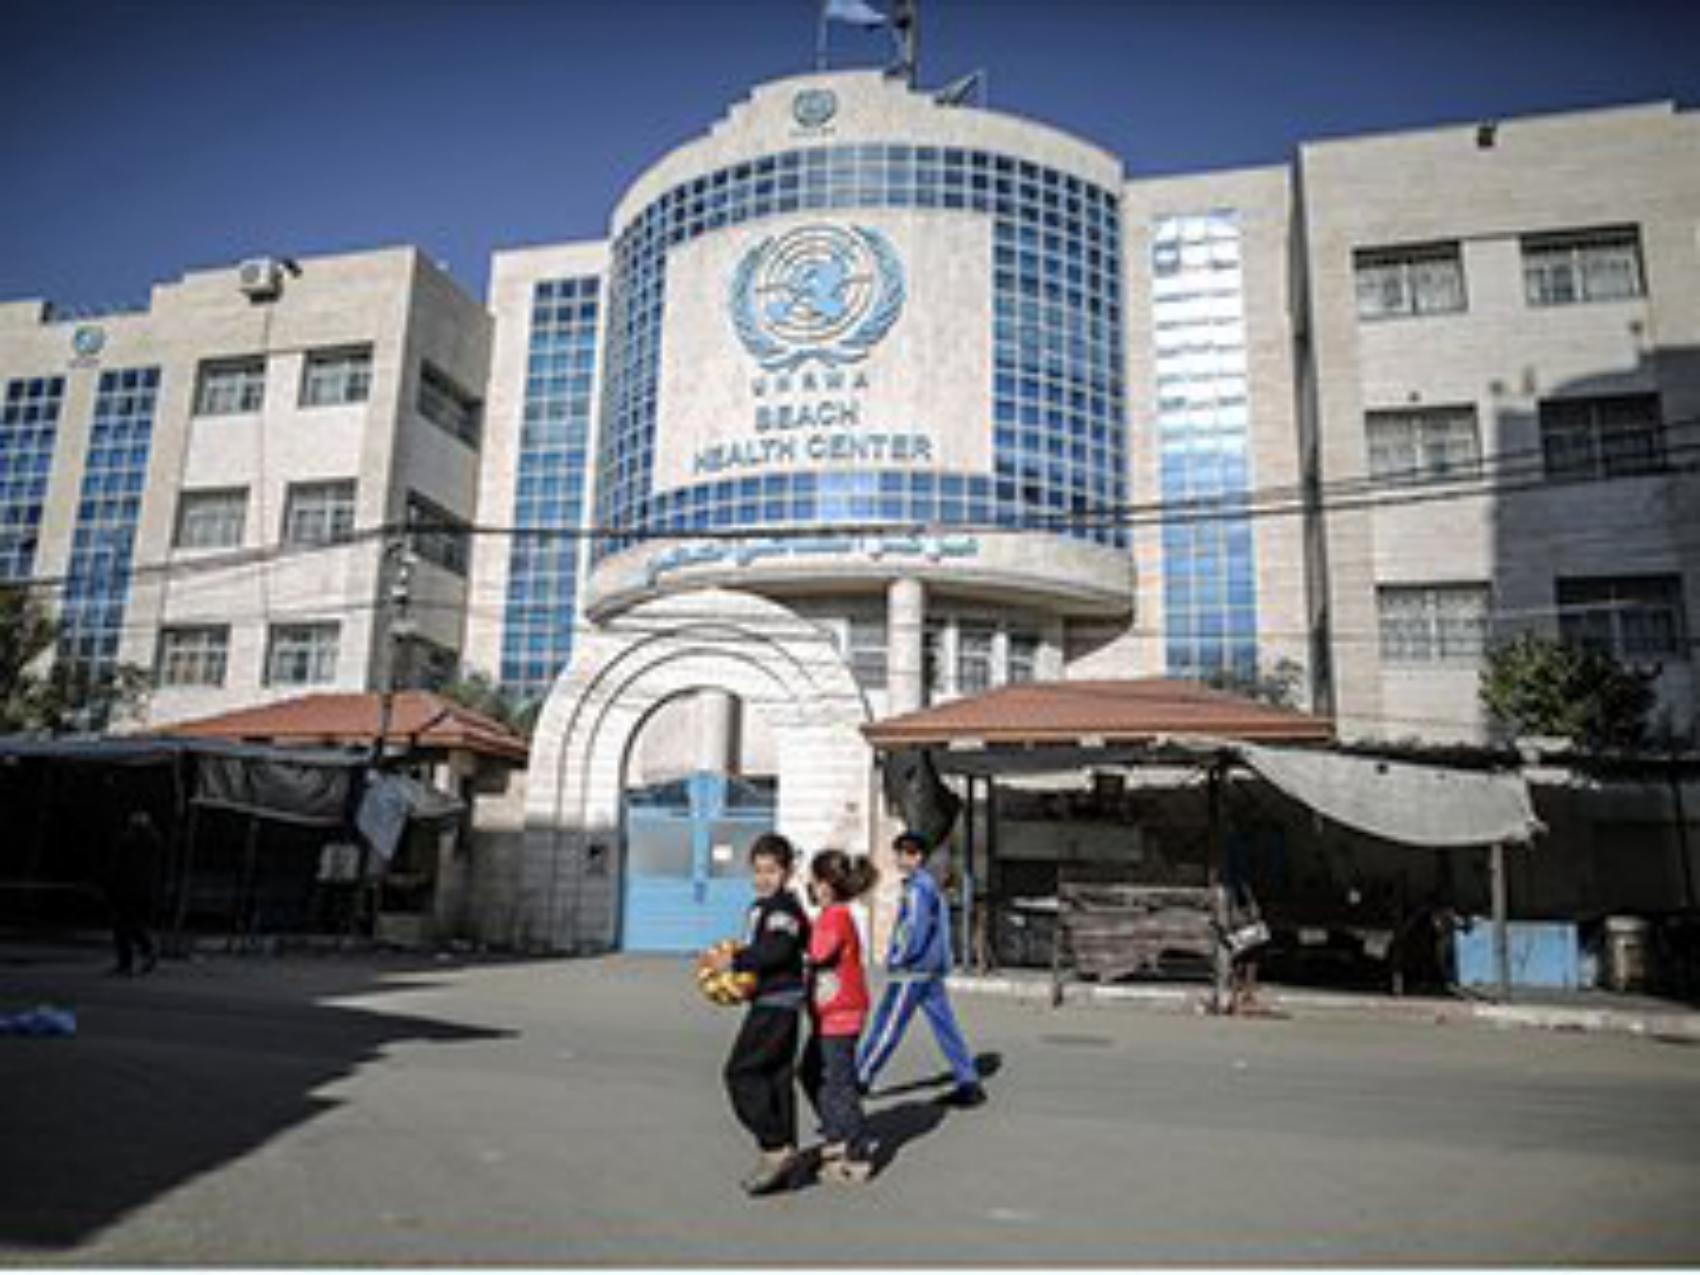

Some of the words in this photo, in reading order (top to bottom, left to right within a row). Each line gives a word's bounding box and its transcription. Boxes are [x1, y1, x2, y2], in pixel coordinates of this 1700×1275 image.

[755, 400, 860, 433] BEACH
[694, 436, 797, 475] HEALTH
[806, 432, 933, 461] CENTER
